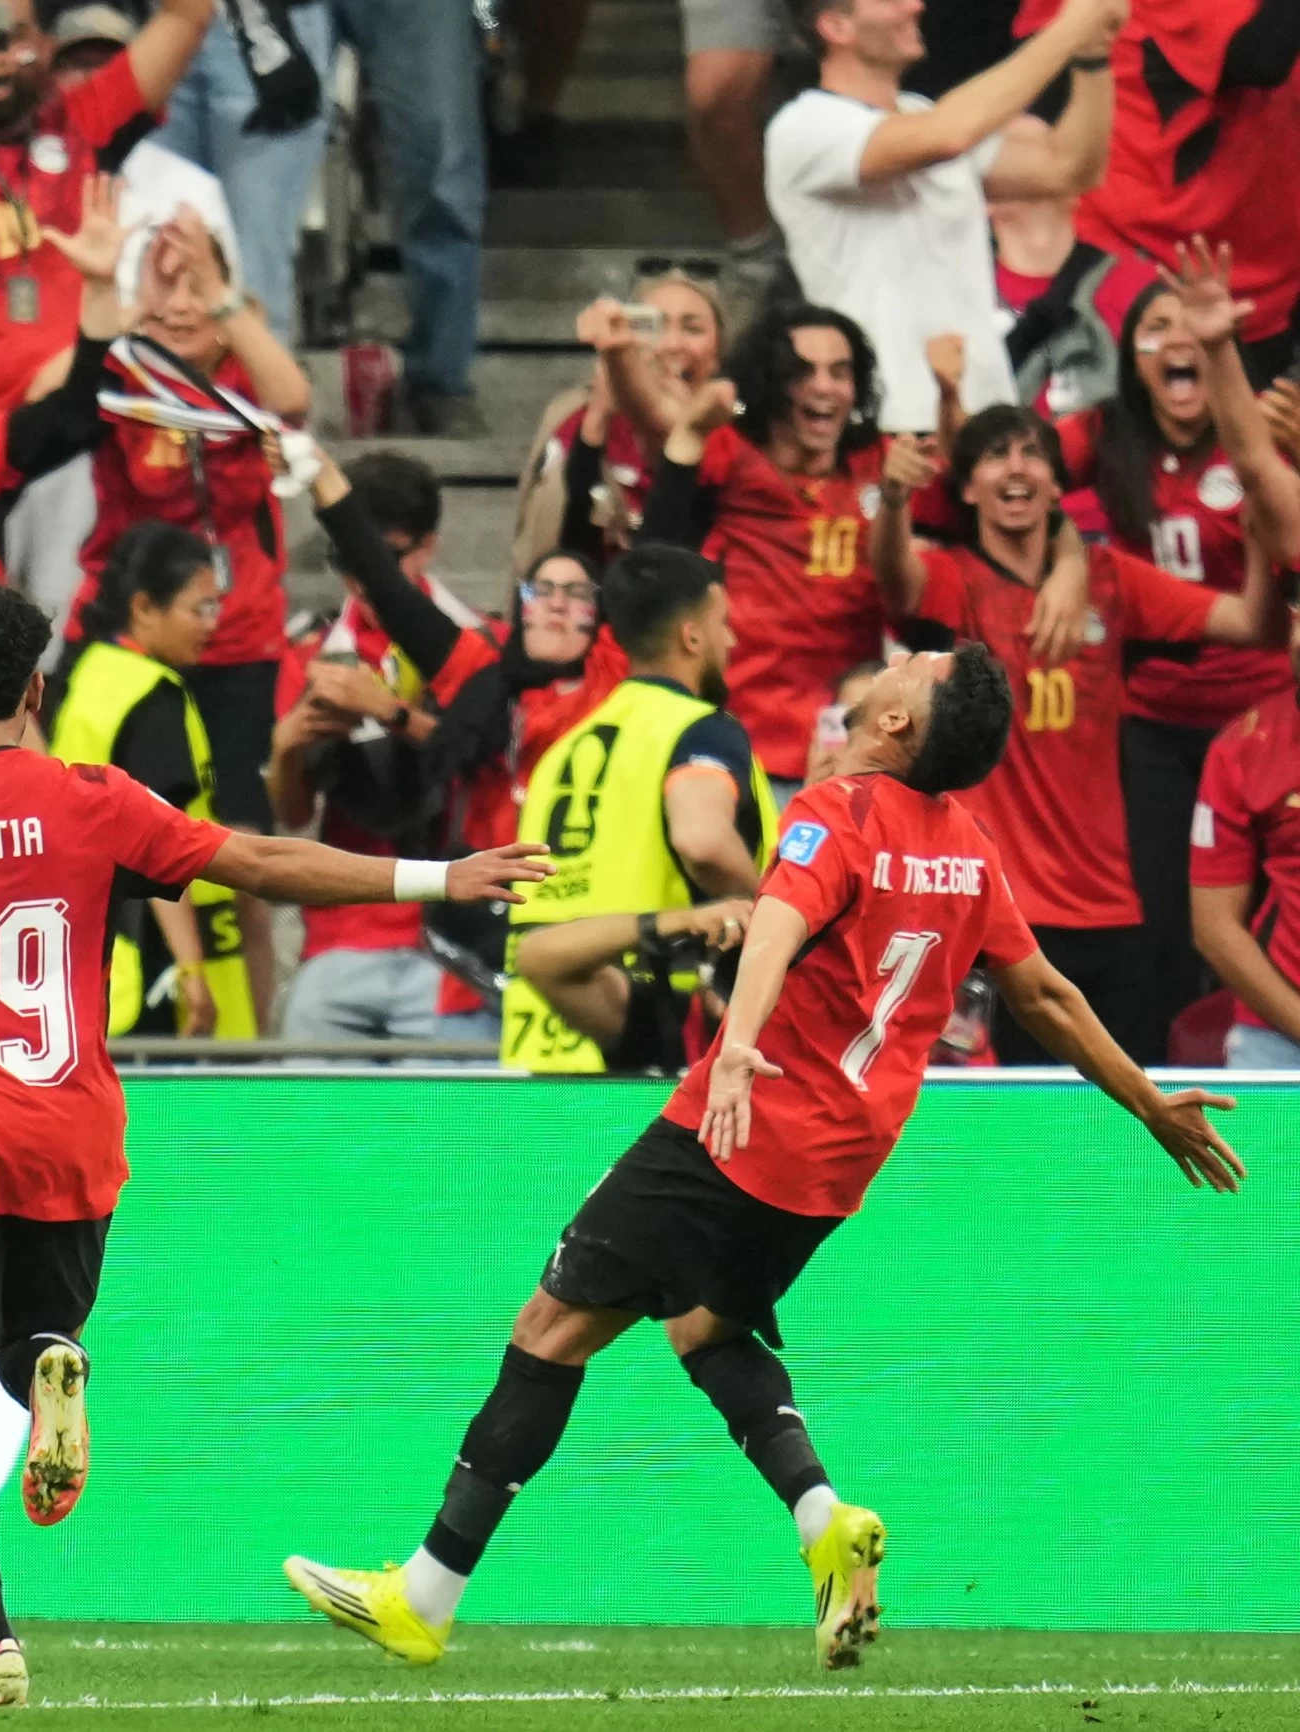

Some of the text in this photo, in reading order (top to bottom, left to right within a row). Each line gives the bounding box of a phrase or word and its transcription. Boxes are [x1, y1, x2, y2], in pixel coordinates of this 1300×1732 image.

[804, 515, 857, 577] 10
[1147, 515, 1204, 581] 10
[1025, 668, 1075, 731] 10
[839, 931, 942, 1093] 7
